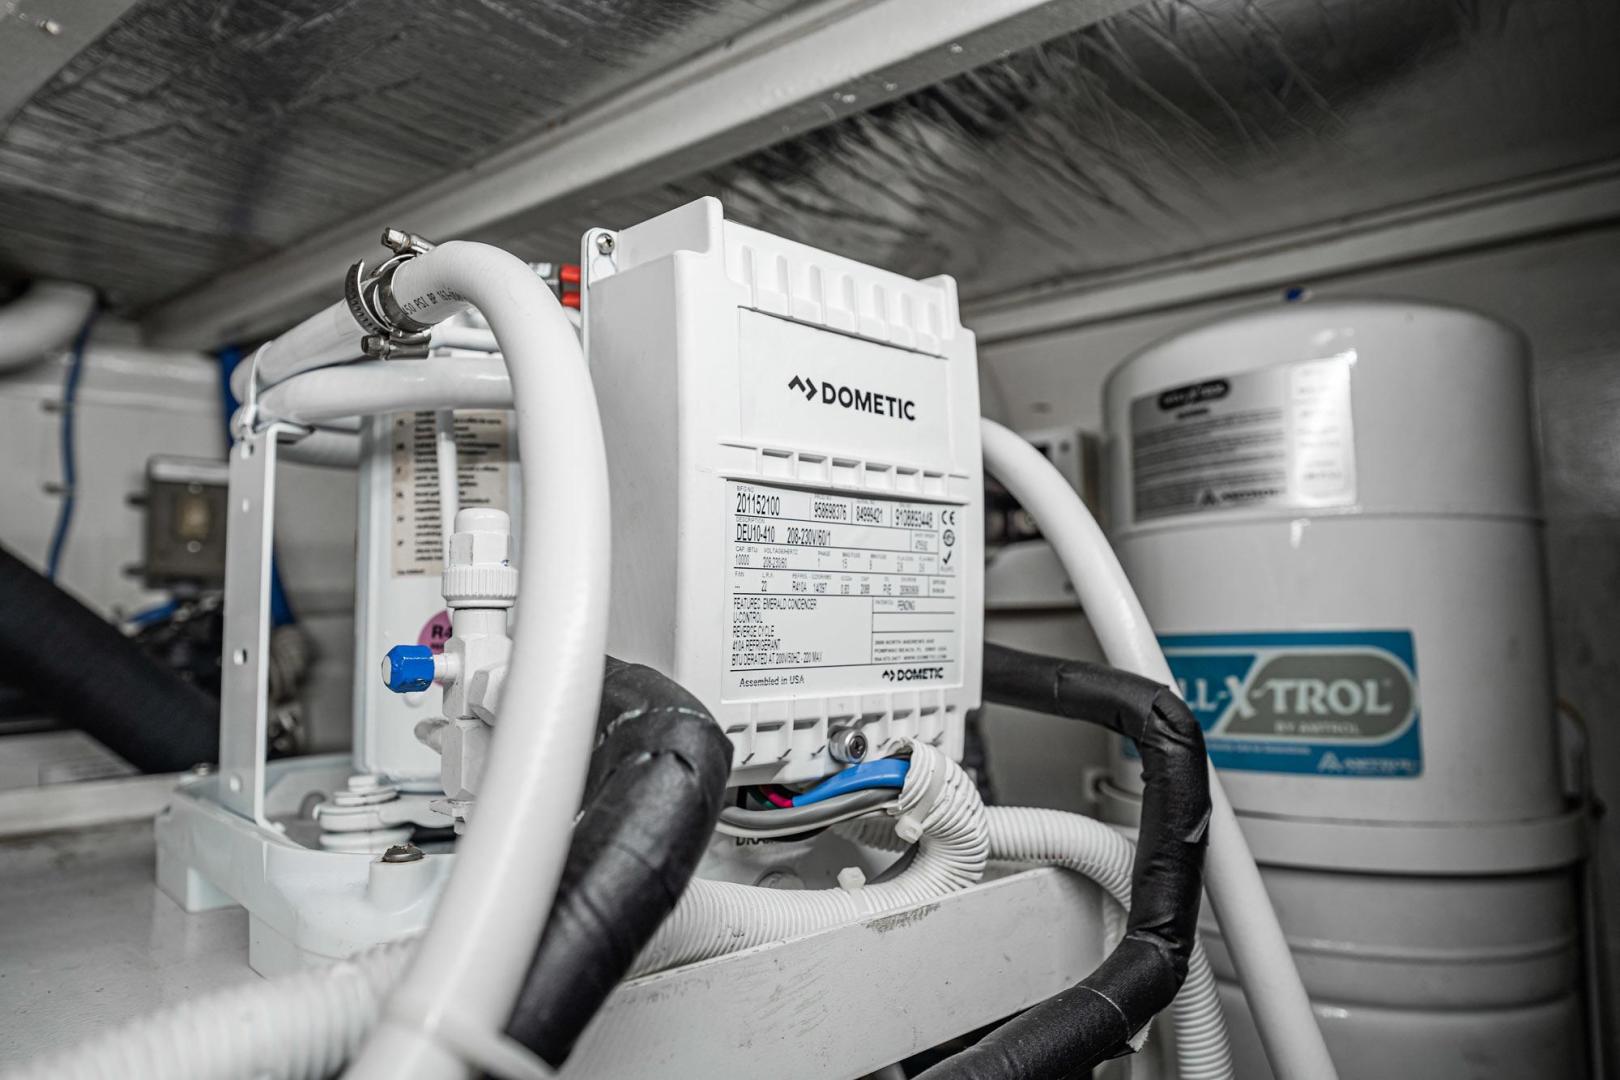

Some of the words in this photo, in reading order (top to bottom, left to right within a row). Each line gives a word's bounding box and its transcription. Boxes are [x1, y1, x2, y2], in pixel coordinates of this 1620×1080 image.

[413, 296, 430, 310] PSI
[821, 381, 916, 421] DOMETIC
[736, 492, 780, 516] 201152100
[736, 523, 775, 543] DEU10-410
[740, 675, 780, 687] Assembled
[781, 677, 788, 685] in
[789, 675, 805, 685] USA
[897, 667, 944, 681] DOMETIC
